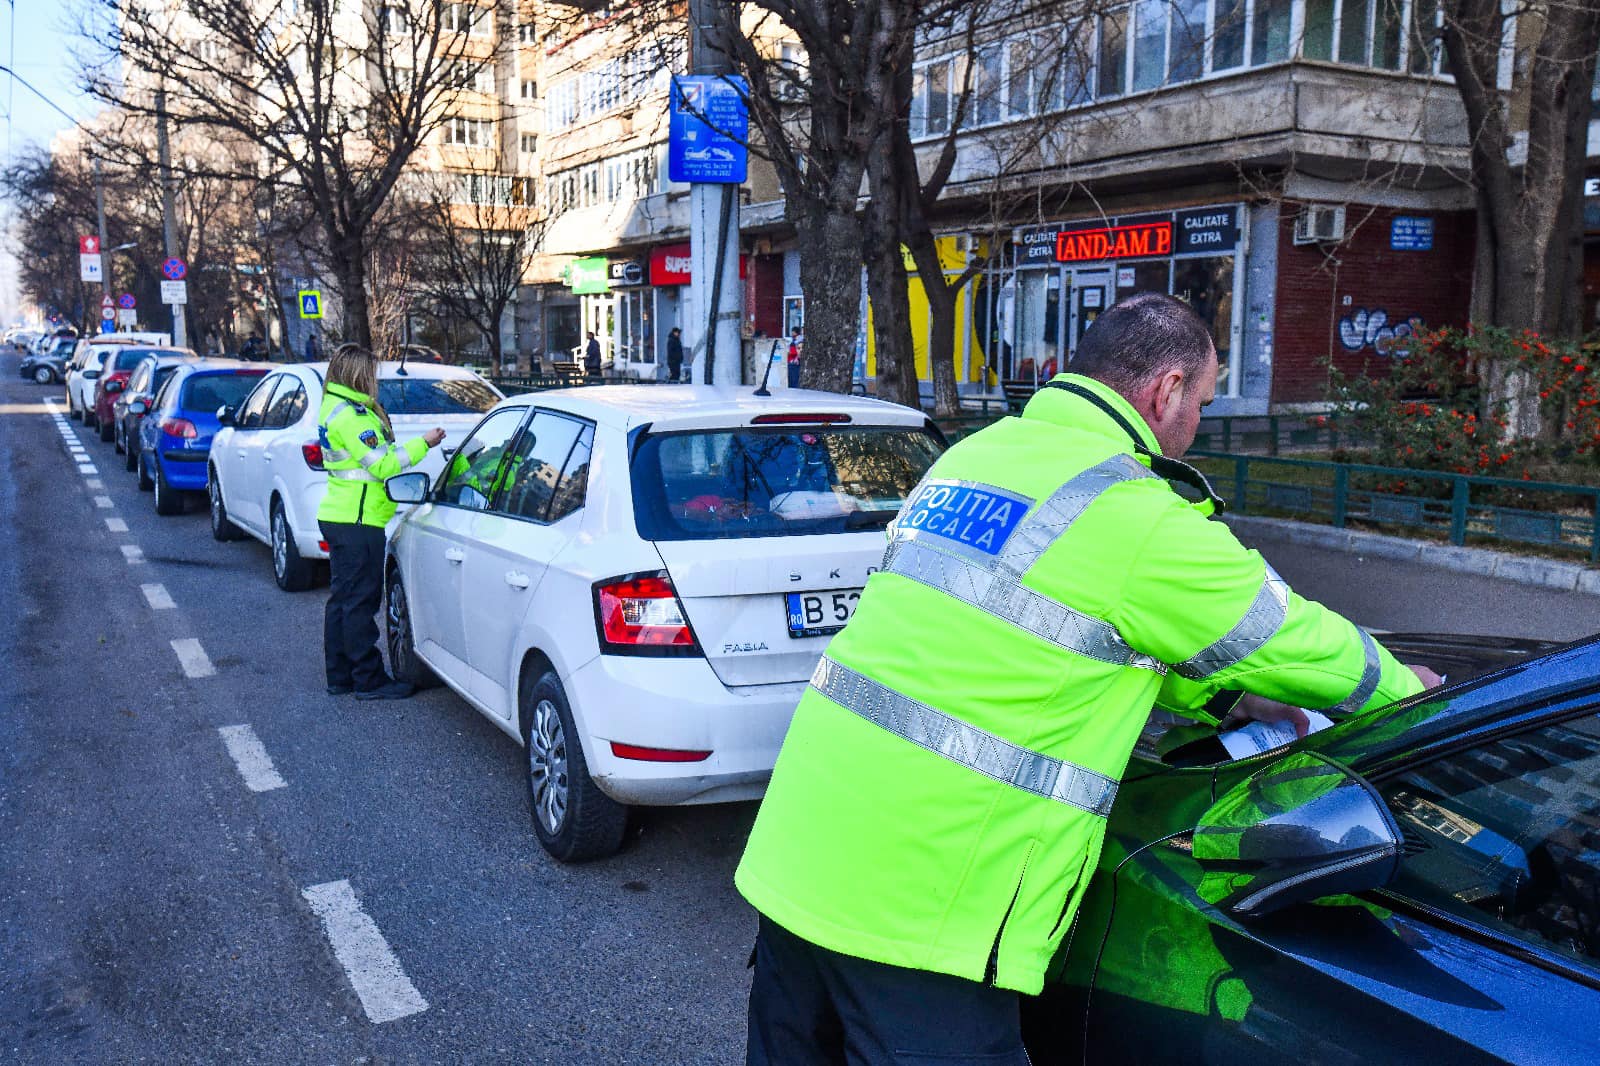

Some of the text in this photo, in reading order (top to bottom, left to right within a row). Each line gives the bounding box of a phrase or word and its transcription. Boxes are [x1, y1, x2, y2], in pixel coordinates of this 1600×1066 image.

[1184, 213, 1229, 229] CALITATE
[1189, 231, 1222, 245] EXTRA
[1028, 244, 1053, 258] EXTRA
[914, 486, 1013, 528] POLITIA
[901, 508, 996, 550] LOCALA
[804, 596, 824, 624] B
[790, 613, 803, 626] RO
[723, 642, 769, 654] FABIA
